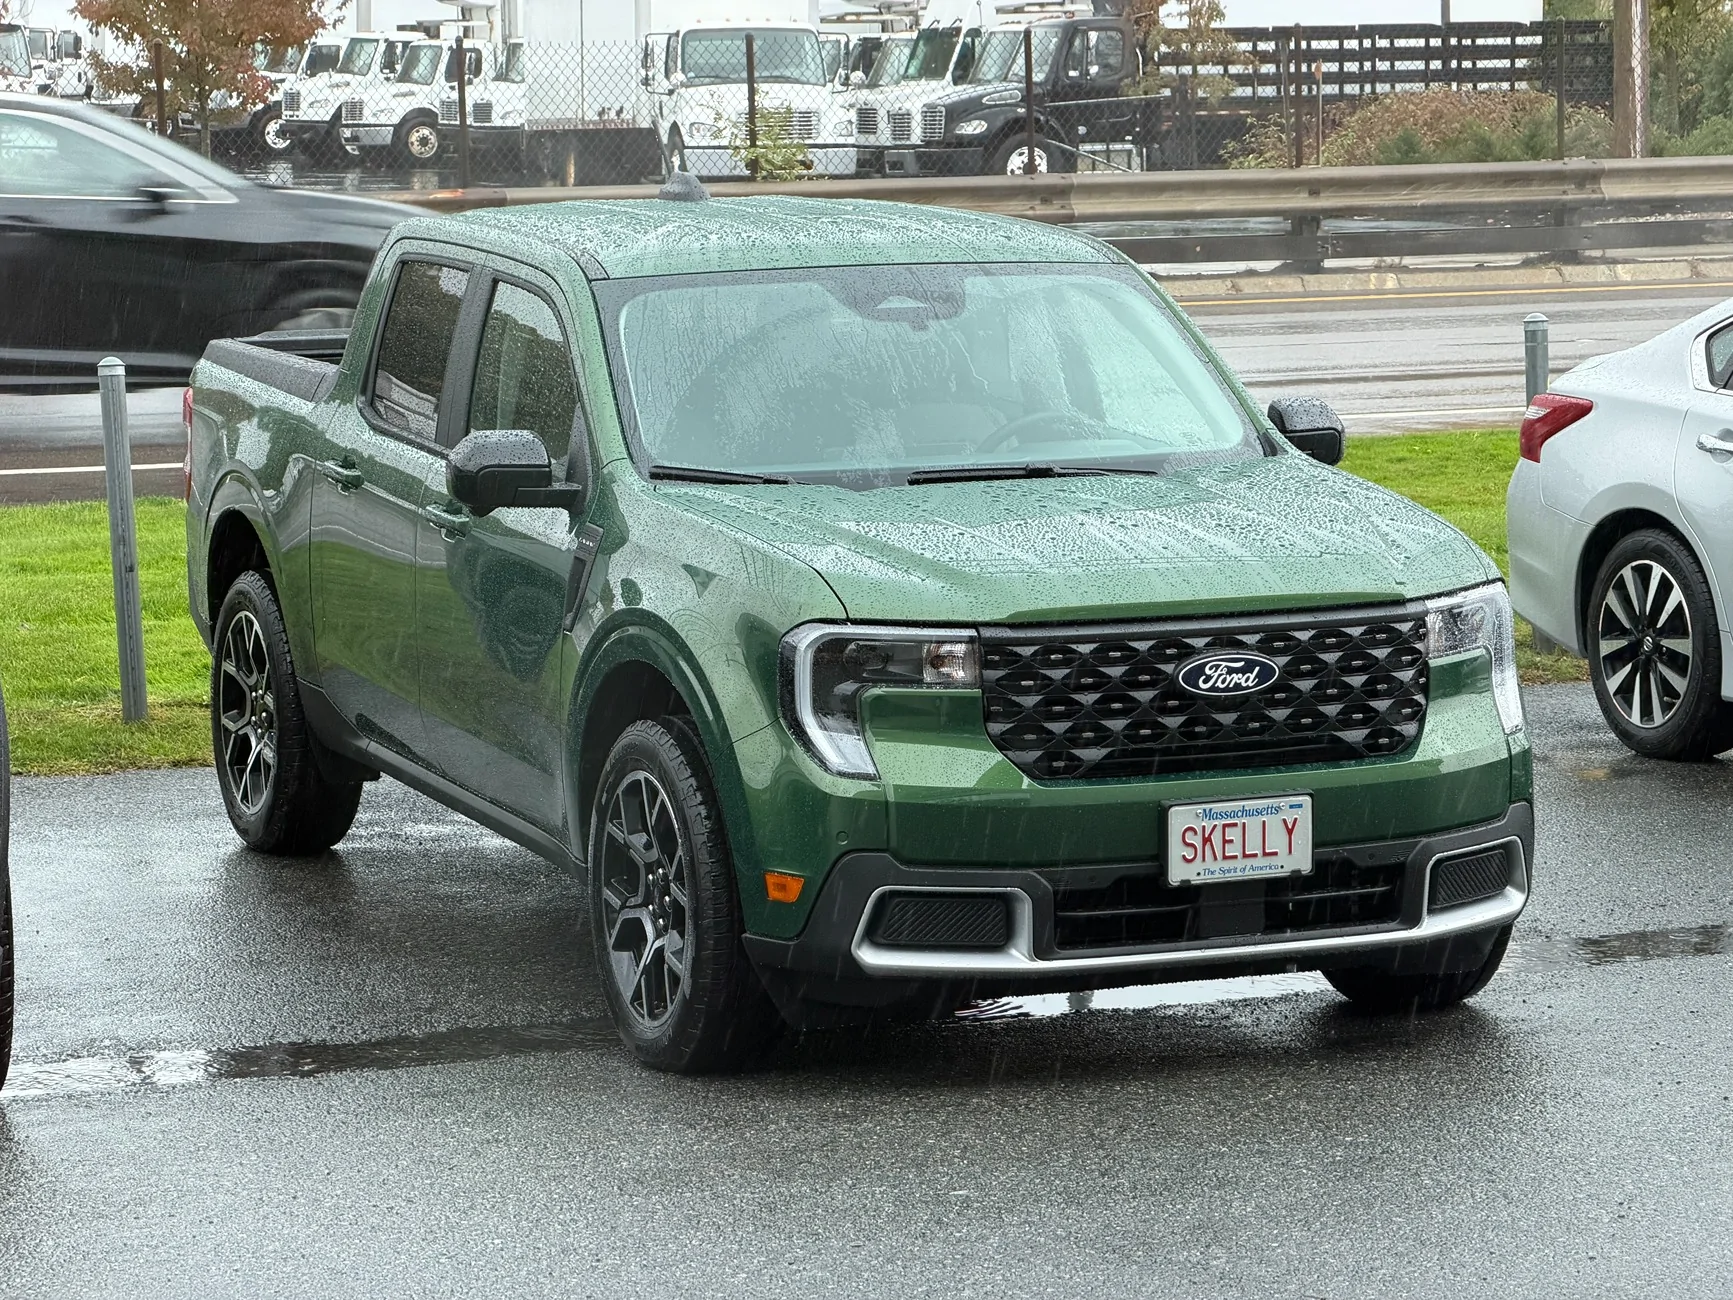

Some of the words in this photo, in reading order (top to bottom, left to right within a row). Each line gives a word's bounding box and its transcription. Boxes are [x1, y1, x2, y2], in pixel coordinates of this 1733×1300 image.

[1199, 661, 1260, 690] Ford
[1201, 804, 1280, 822] Massachusetts
[1181, 816, 1299, 864] SKELLY
[1203, 868, 1216, 877] The
[1218, 866, 1238, 876] Spirit
[1239, 865, 1248, 875] of
[1248, 863, 1279, 873] America
